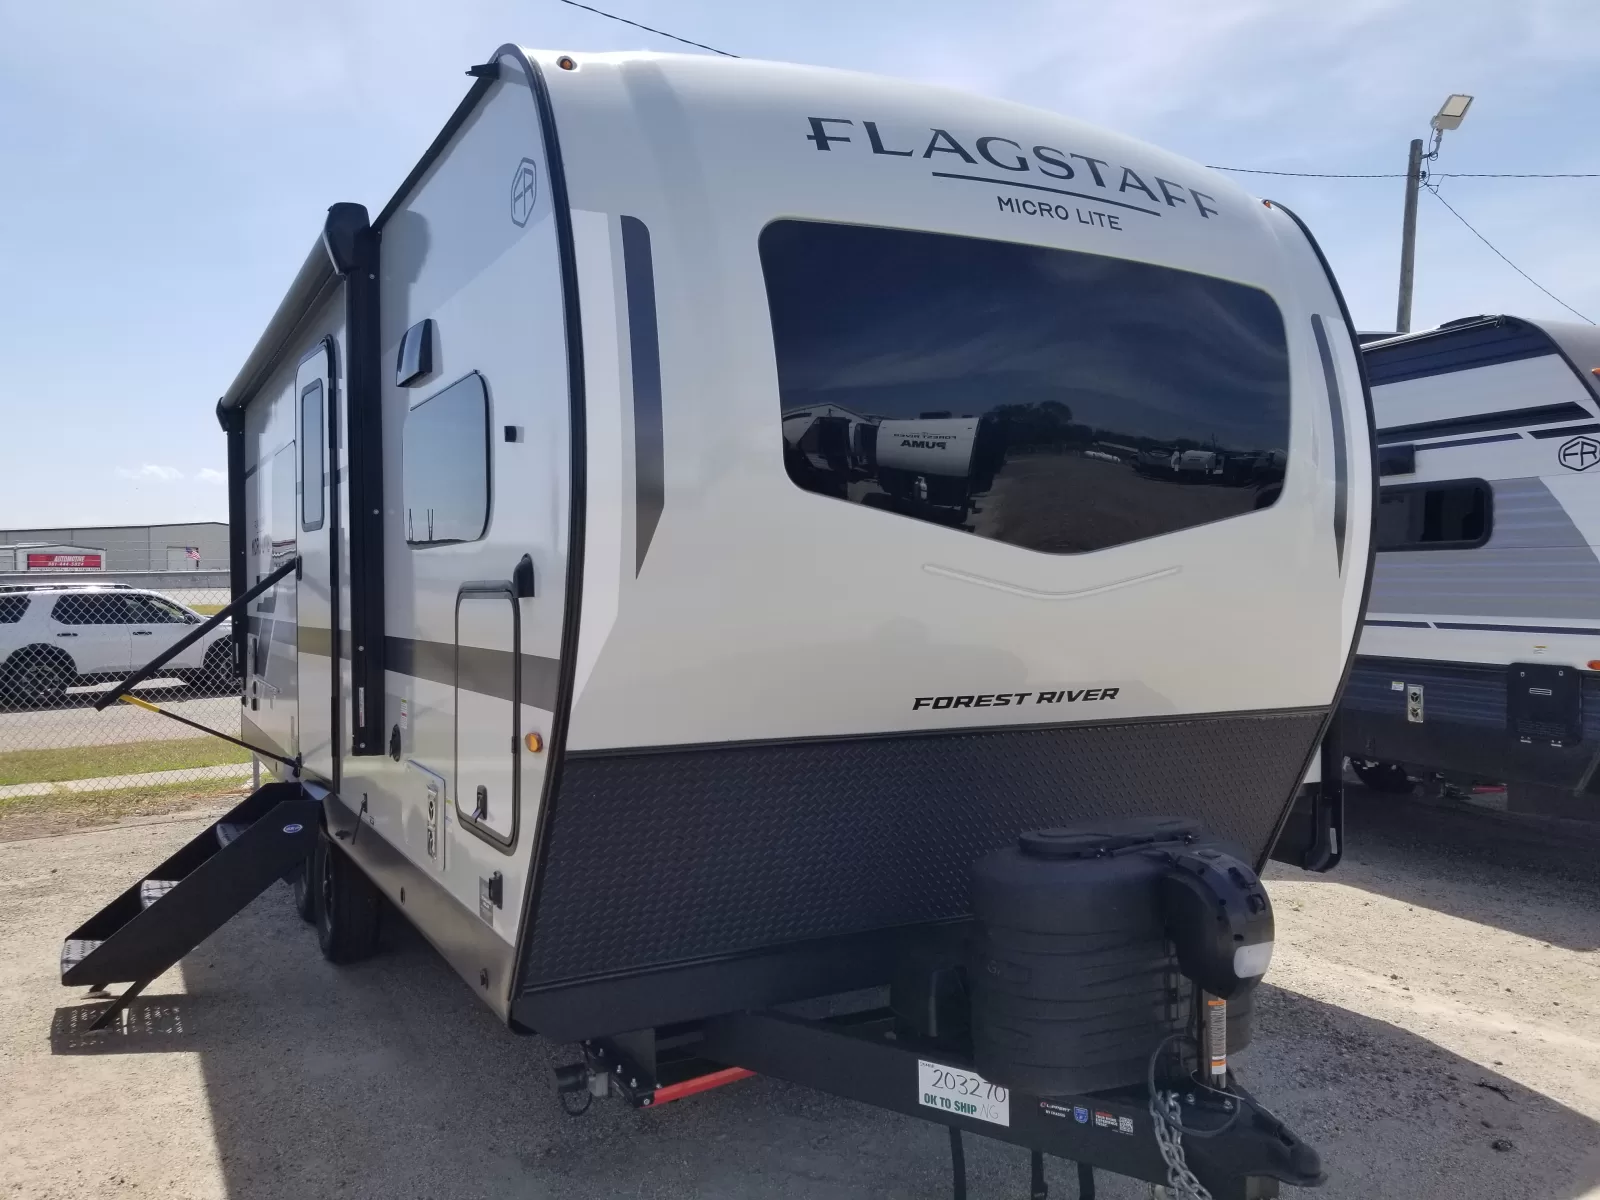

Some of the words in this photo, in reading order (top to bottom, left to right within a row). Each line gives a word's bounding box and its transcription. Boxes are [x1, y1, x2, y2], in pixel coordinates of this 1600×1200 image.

[806, 115, 1220, 219] FLAGSTAFF
[997, 195, 1069, 221] MICRO
[1076, 208, 1123, 231] LITE
[912, 692, 1032, 711] FOREST
[1036, 687, 1120, 704] RIVER
[931, 1068, 1007, 1103] 203270
[923, 1092, 938, 1106] OK
[939, 1096, 952, 1109] TO
[953, 1100, 978, 1115] SHIP
